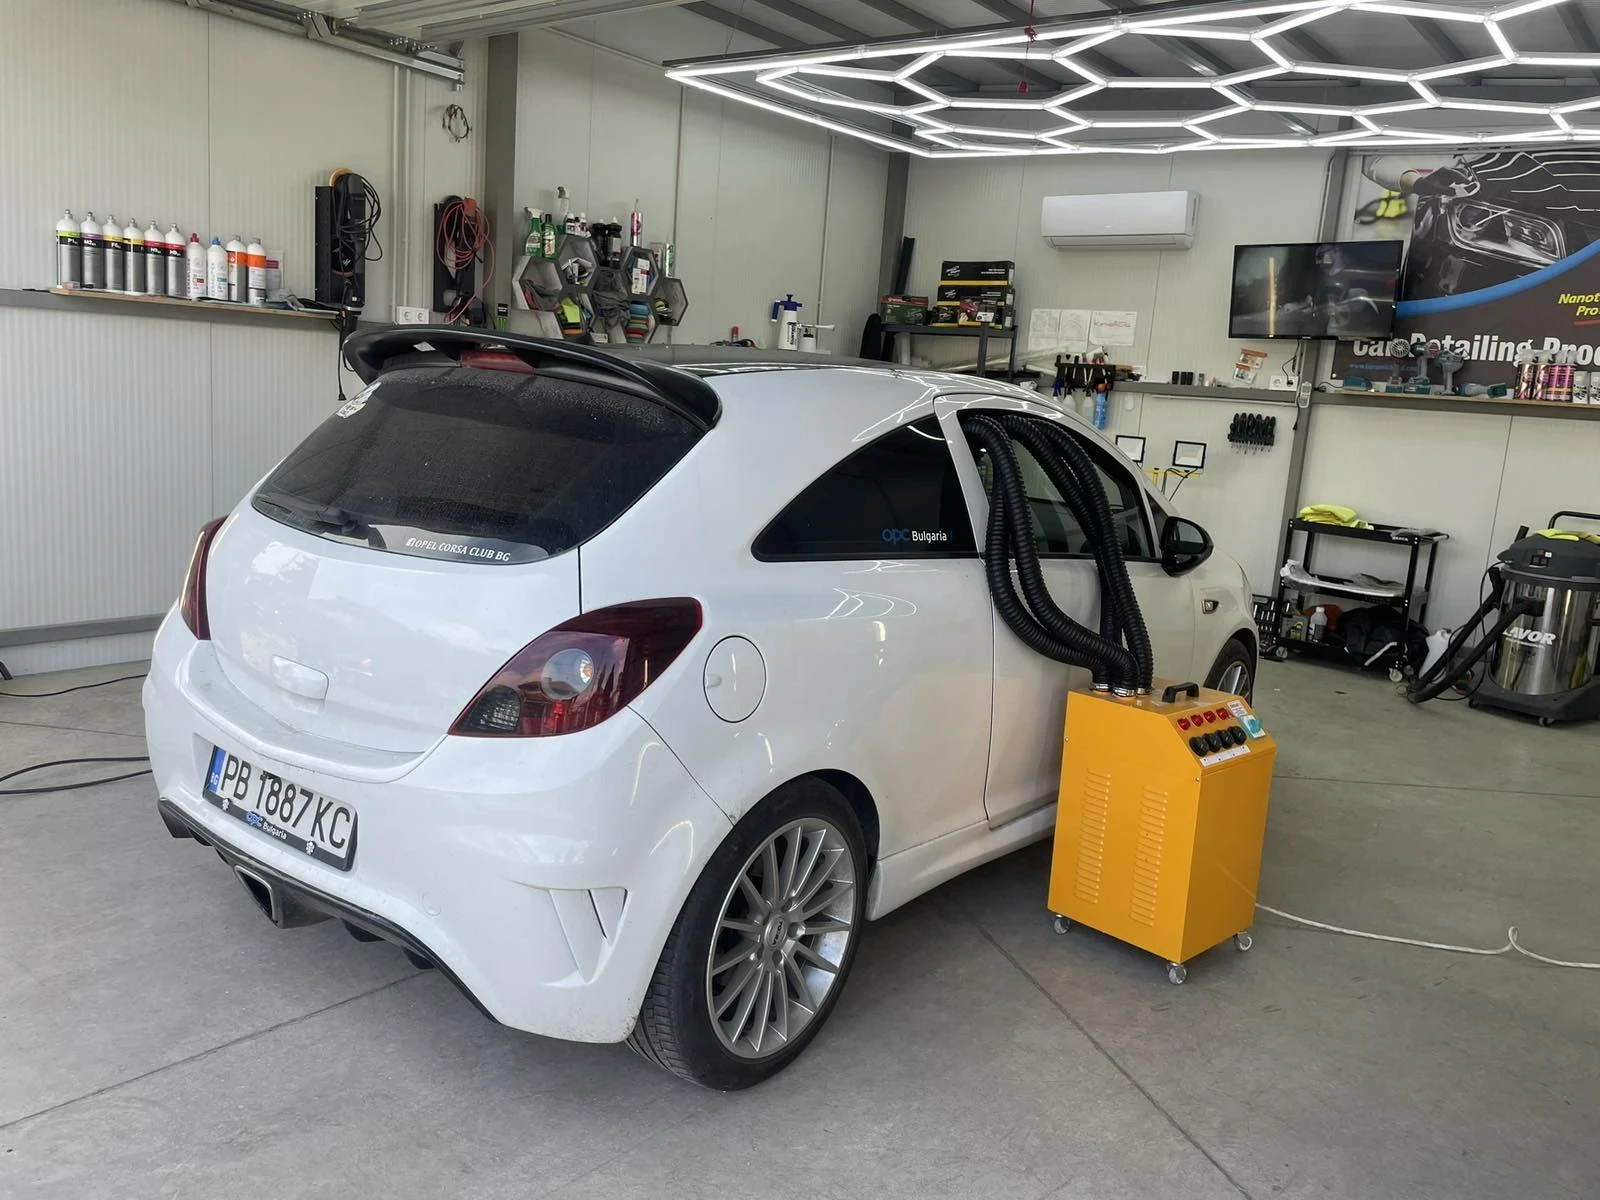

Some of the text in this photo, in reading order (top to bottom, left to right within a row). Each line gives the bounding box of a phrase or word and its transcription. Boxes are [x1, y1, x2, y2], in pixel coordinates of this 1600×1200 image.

[1576, 305, 1600, 316] Pro
[911, 530, 948, 544] Bulgaria
[415, 540, 511, 562] OPEL CORSA CLUB BG
[1502, 626, 1557, 645] LAVOR
[220, 754, 351, 849] PB 1887 KC
[262, 820, 287, 840] Bulgaria
